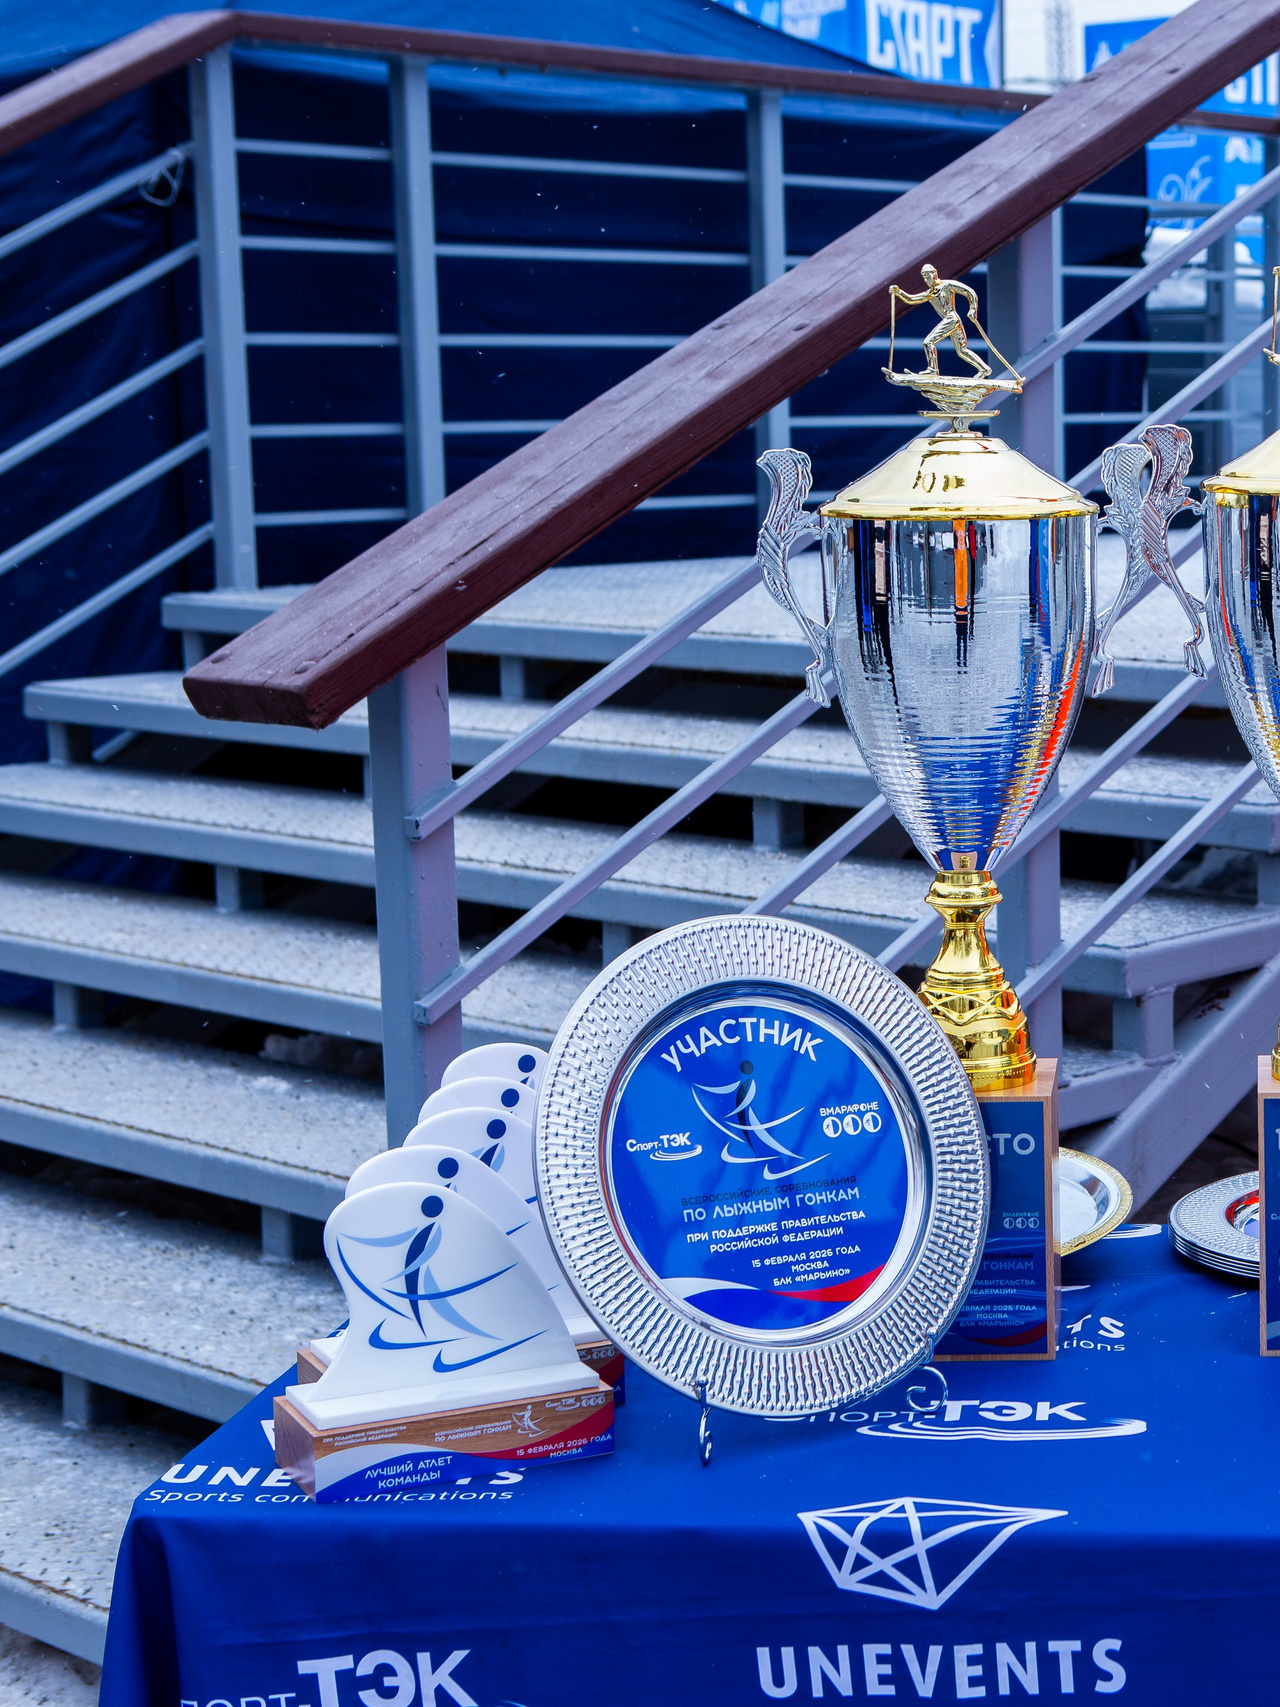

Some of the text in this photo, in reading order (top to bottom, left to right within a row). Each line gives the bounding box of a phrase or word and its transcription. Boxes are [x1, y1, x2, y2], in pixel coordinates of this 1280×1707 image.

[661, 1017, 824, 1072] УЧАСТНИК
[681, 1175, 857, 1207] ВСЕРОССИЙСКИЕ СОРЕВНОВАНИЯ
[683, 1187, 860, 1223] ПО ЛЫЖНЫМ ГОНКАМ
[687, 1210, 865, 1244] ПРИ ПОДДЕРЖКЕ ПРАВИТЕЛЬСТВА
[710, 1226, 844, 1253] РОССИЙСКОЙ ФЕДЕРАЦИИ
[751, 1245, 861, 1268] 15 ФЕВРАЛЯ 2026 ГОДА
[791, 1260, 829, 1273] МОСКВА
[983, 1261, 1034, 1271] ГОНКАМ
[773, 1268, 851, 1287] БЛК «МАРЬИНО»
[434, 1435, 446, 1443] ПО
[483, 1424, 512, 1434] ГОНКАМ
[527, 1442, 565, 1454] ФЕВРАЛЯ
[566, 1438, 588, 1448] 2026
[590, 1433, 612, 1443] ГОДА
[550, 1447, 583, 1458] МОСКВА
[365, 1455, 453, 1479] ЛУЧШИЙ АТЛЕТ
[378, 1470, 441, 1489] КОМАНДЫ
[144, 1489, 244, 1504] Sports
[756, 1638, 1127, 1699] UNEVENTS
